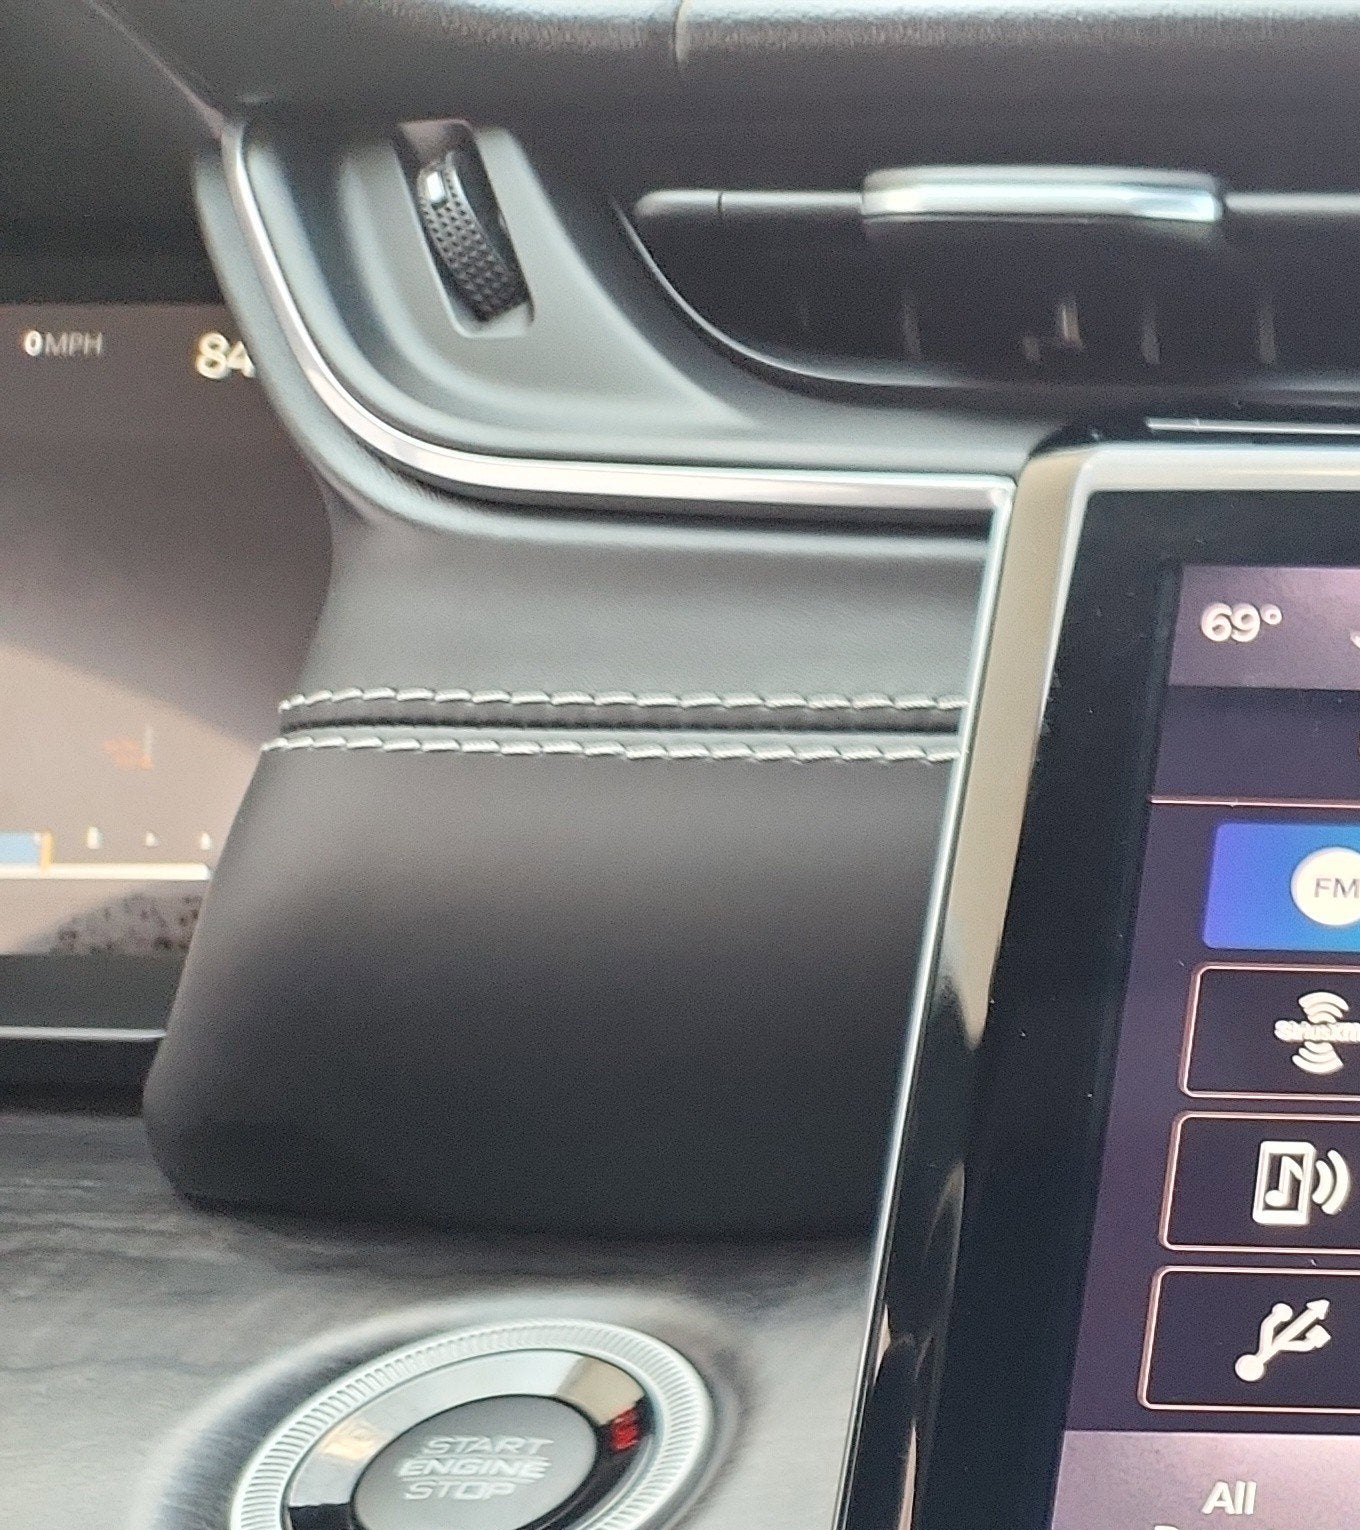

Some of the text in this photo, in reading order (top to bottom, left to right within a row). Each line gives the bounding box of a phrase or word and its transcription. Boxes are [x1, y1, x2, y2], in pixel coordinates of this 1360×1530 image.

[1314, 877, 1360, 899] FM
[423, 1435, 554, 1455] START
[397, 1455, 552, 1479] ENGINE
[404, 1480, 517, 1501] STOP
[1201, 1481, 1257, 1515] All
